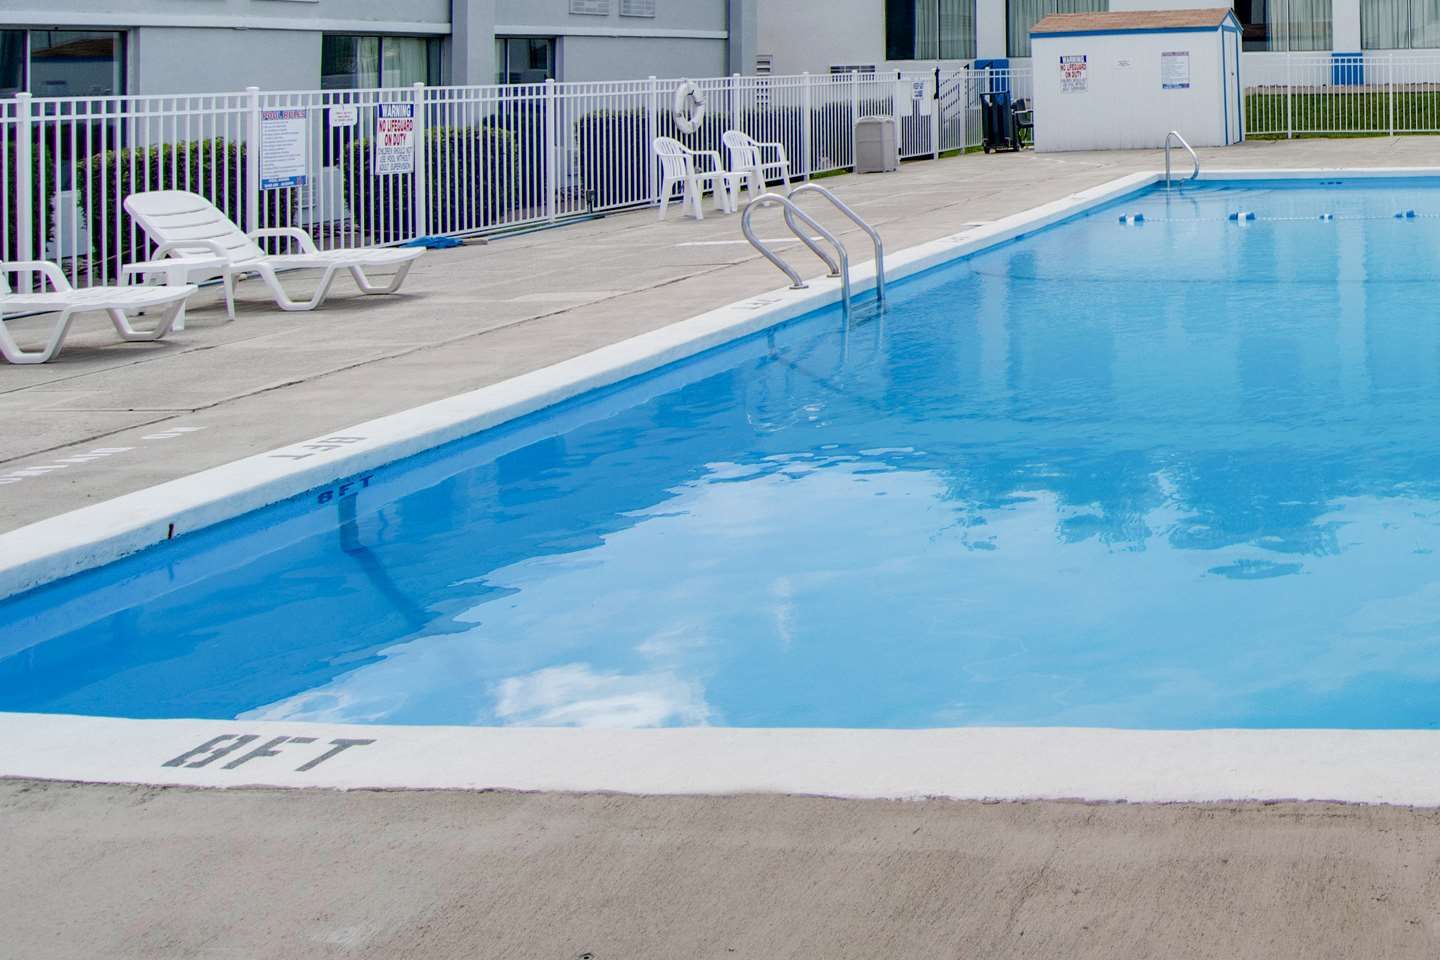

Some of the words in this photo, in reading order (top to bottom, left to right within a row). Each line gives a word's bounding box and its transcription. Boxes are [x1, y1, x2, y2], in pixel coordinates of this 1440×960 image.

[381, 104, 411, 118] WARNING
[378, 119, 387, 132] NO
[387, 119, 413, 132] LIFEGUARD
[384, 133, 392, 146] ON
[393, 133, 407, 146] DUTY
[161, 734, 377, 772] 8FT
